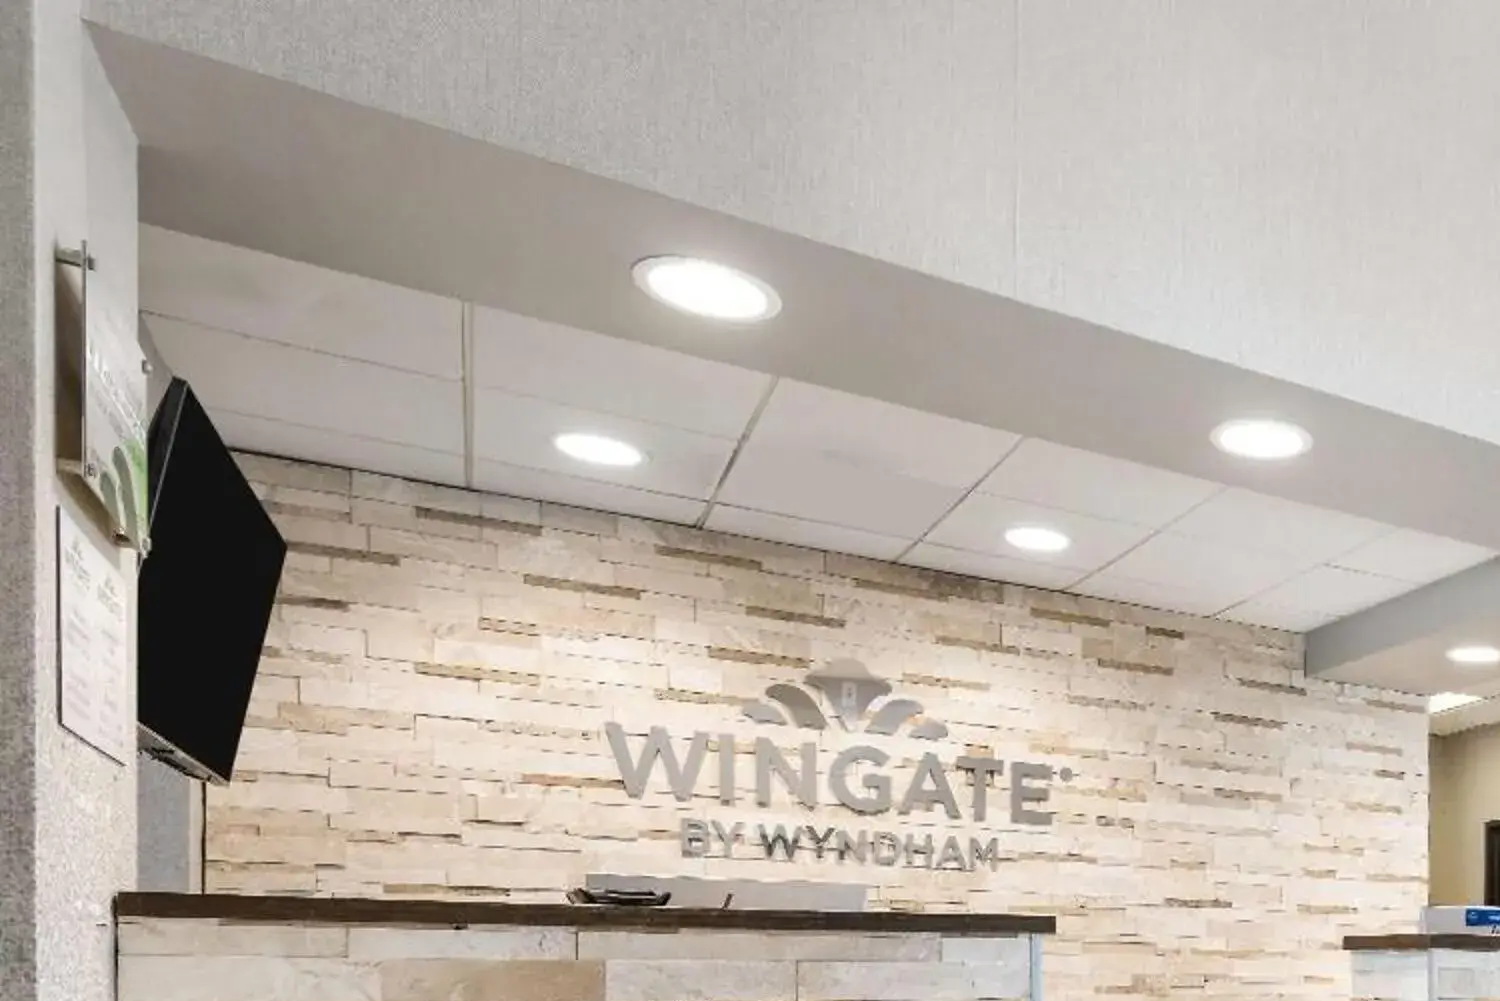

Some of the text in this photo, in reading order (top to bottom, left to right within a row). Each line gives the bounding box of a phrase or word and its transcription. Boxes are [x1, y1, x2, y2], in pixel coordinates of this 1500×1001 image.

[604, 721, 1054, 826] WINGATE
[680, 817, 1001, 872] BY WYNDHAM
